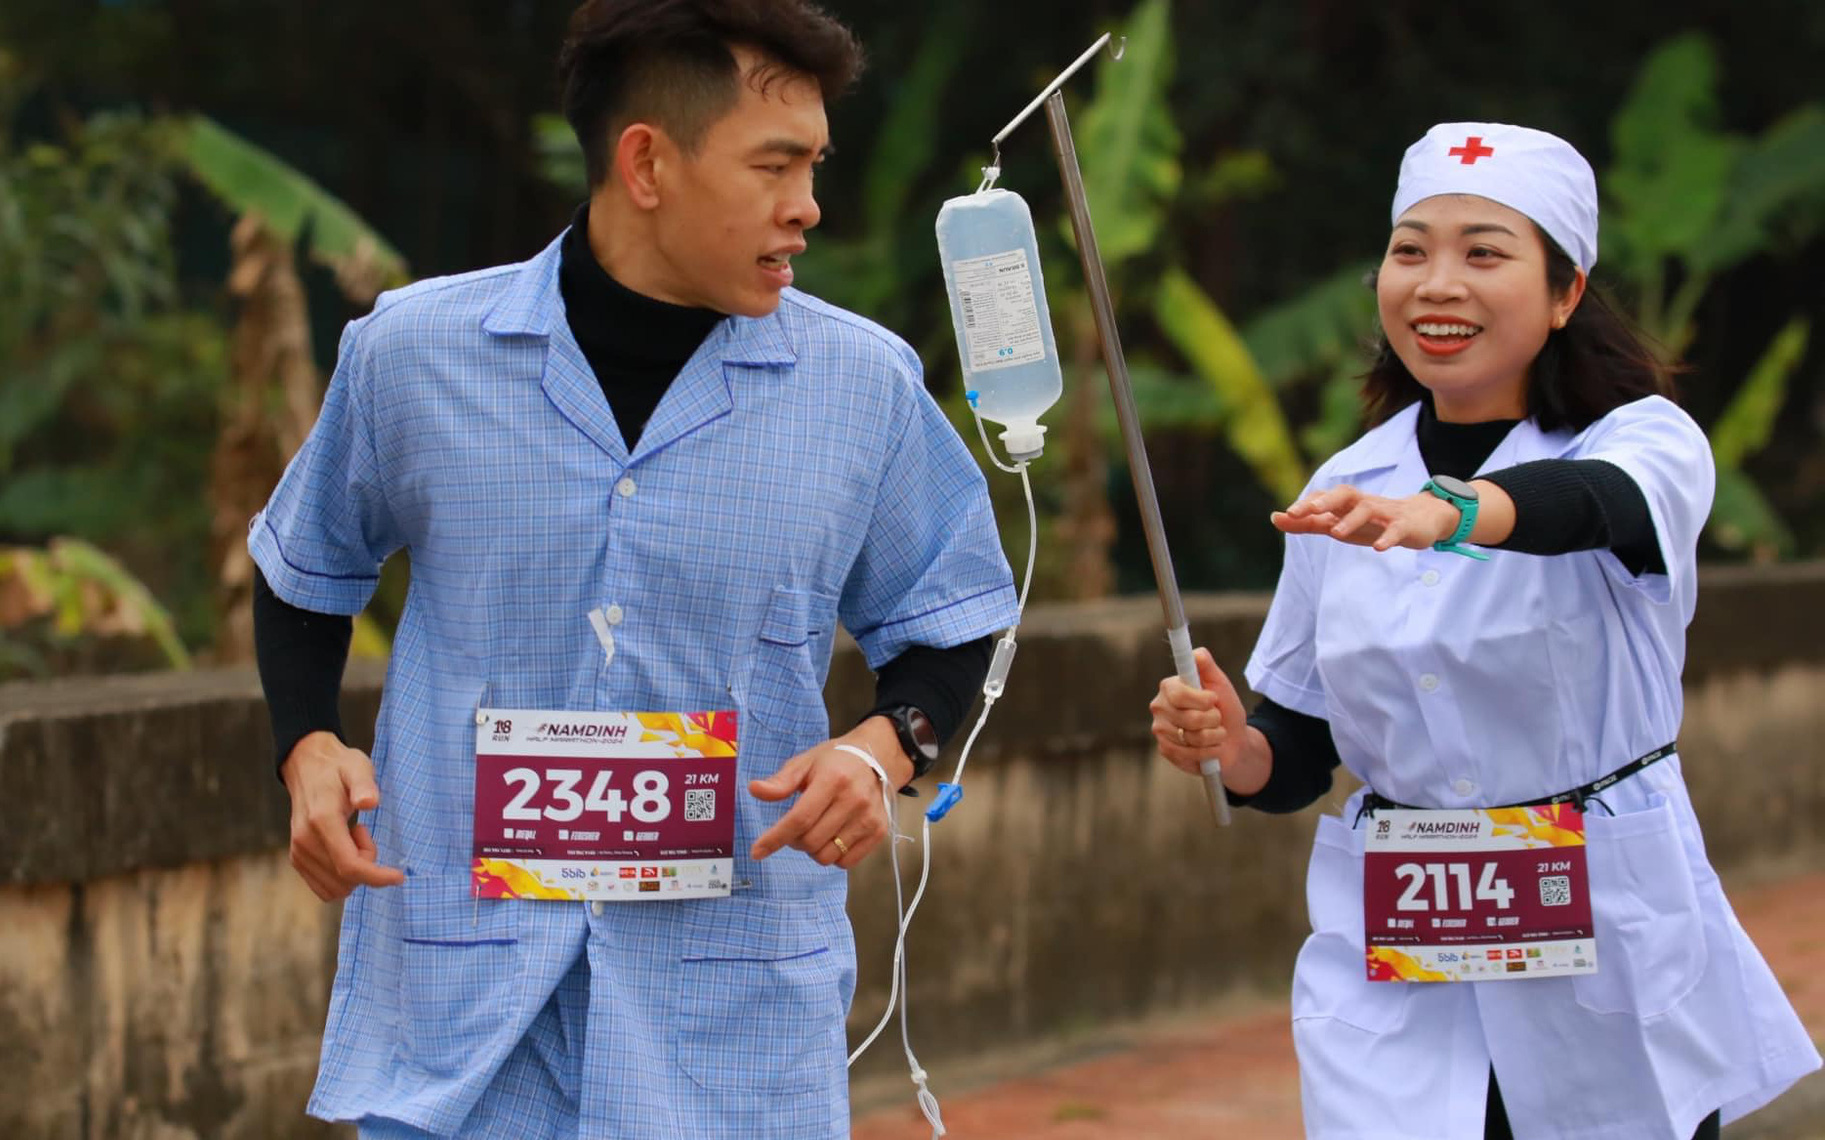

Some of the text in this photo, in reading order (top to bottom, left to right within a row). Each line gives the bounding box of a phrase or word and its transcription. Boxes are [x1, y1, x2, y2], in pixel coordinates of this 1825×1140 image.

[684, 773, 719, 785] 21 KM
[502, 767, 672, 823] 2348
[1537, 861, 1571, 873] 21 KM
[1394, 861, 1515, 911] 2114
